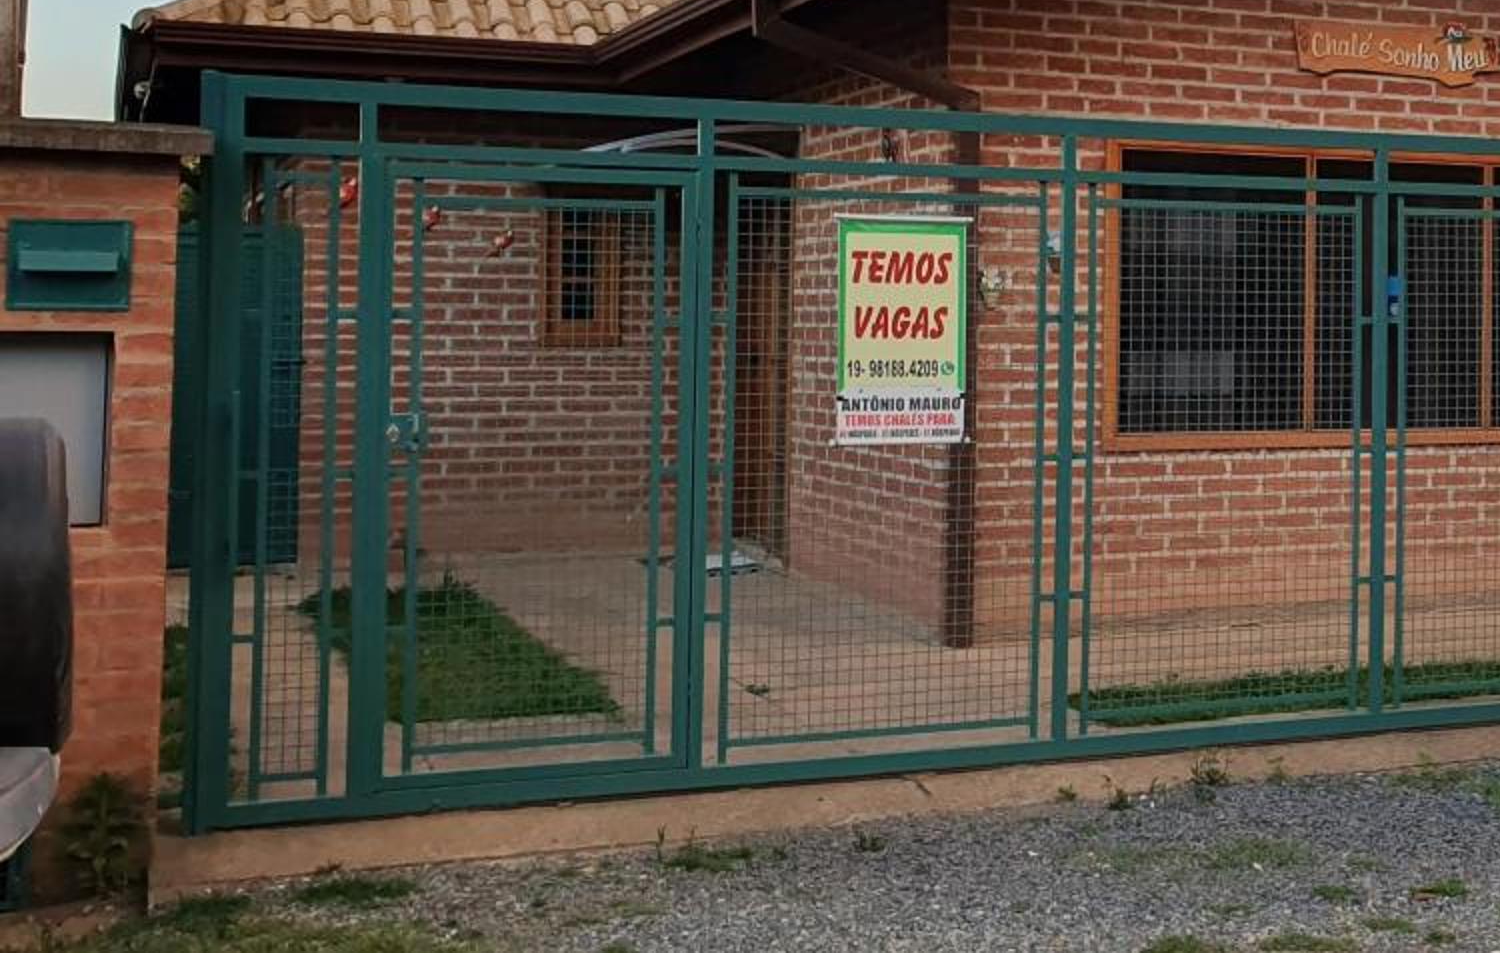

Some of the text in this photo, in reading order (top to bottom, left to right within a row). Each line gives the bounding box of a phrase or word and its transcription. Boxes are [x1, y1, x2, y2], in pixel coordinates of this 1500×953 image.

[1311, 32, 1374, 58] Chalé
[1375, 38, 1440, 72] Sonho
[852, 250, 953, 285] TEMOS
[854, 306, 949, 340] VAGAS
[869, 359, 939, 378] 98188.4209
[841, 394, 961, 412] ANTÔNIO MAURO
[845, 414, 881, 427] TEMOS
